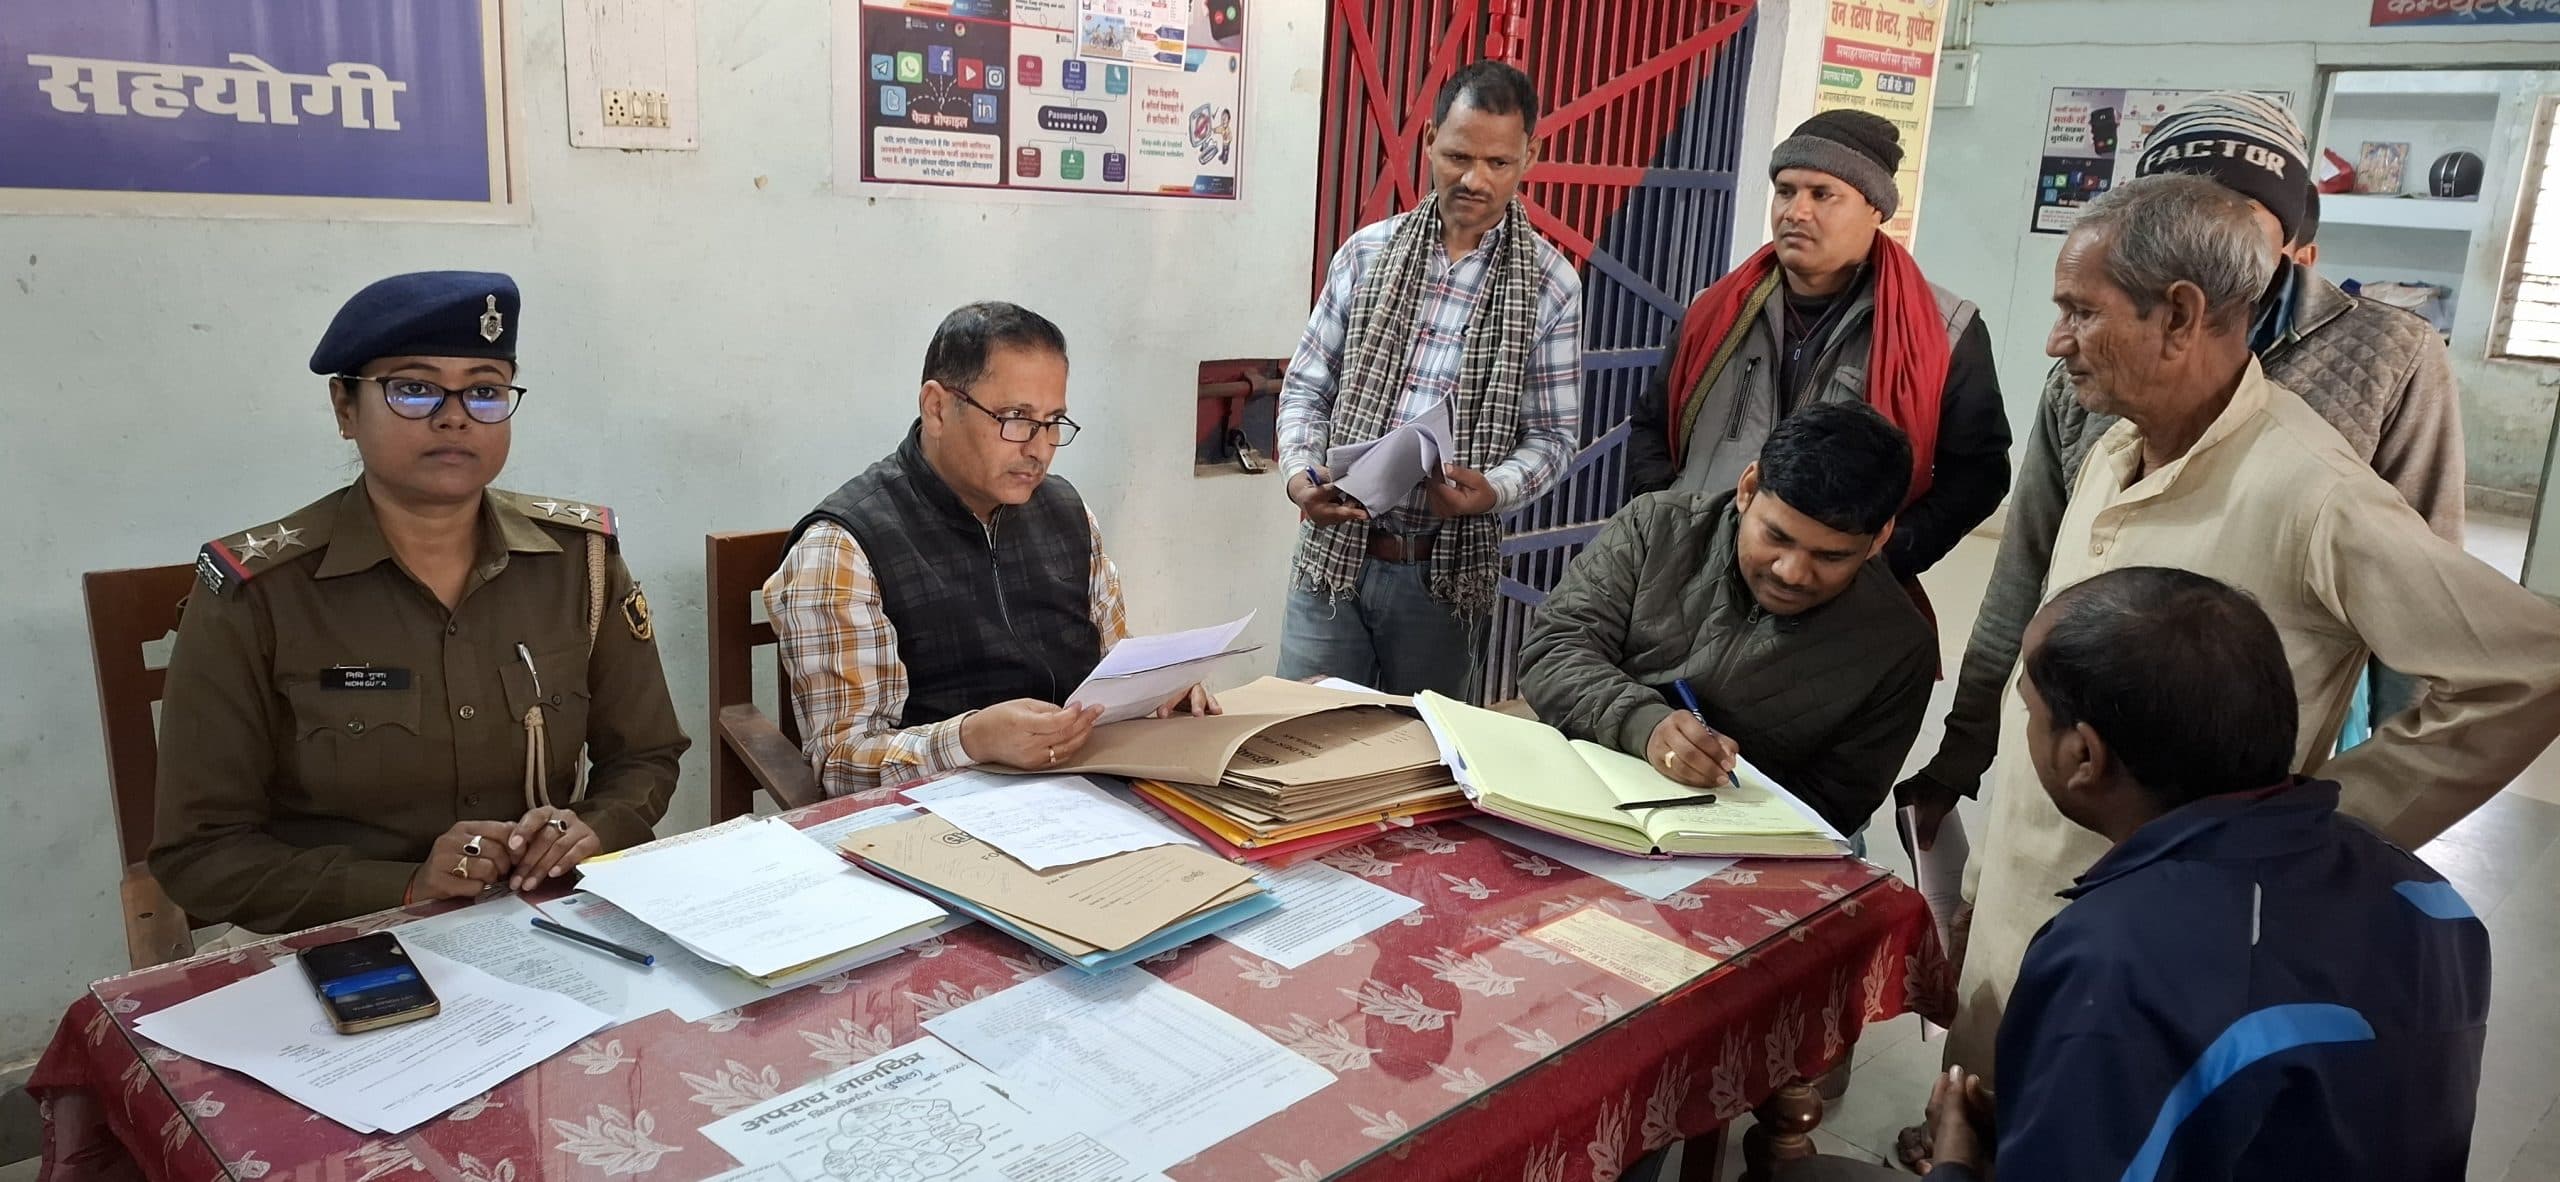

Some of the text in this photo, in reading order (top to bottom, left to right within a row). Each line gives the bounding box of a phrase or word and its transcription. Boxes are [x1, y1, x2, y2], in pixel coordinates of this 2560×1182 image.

[1831, 1, 1847, 27] वन
[26, 52, 407, 131] सहयोगी
[1047, 109, 1099, 125] Password Safety
[2143, 139, 2287, 181] FACTOR
[741, 1051, 926, 1132] अपराध मानचित्र
